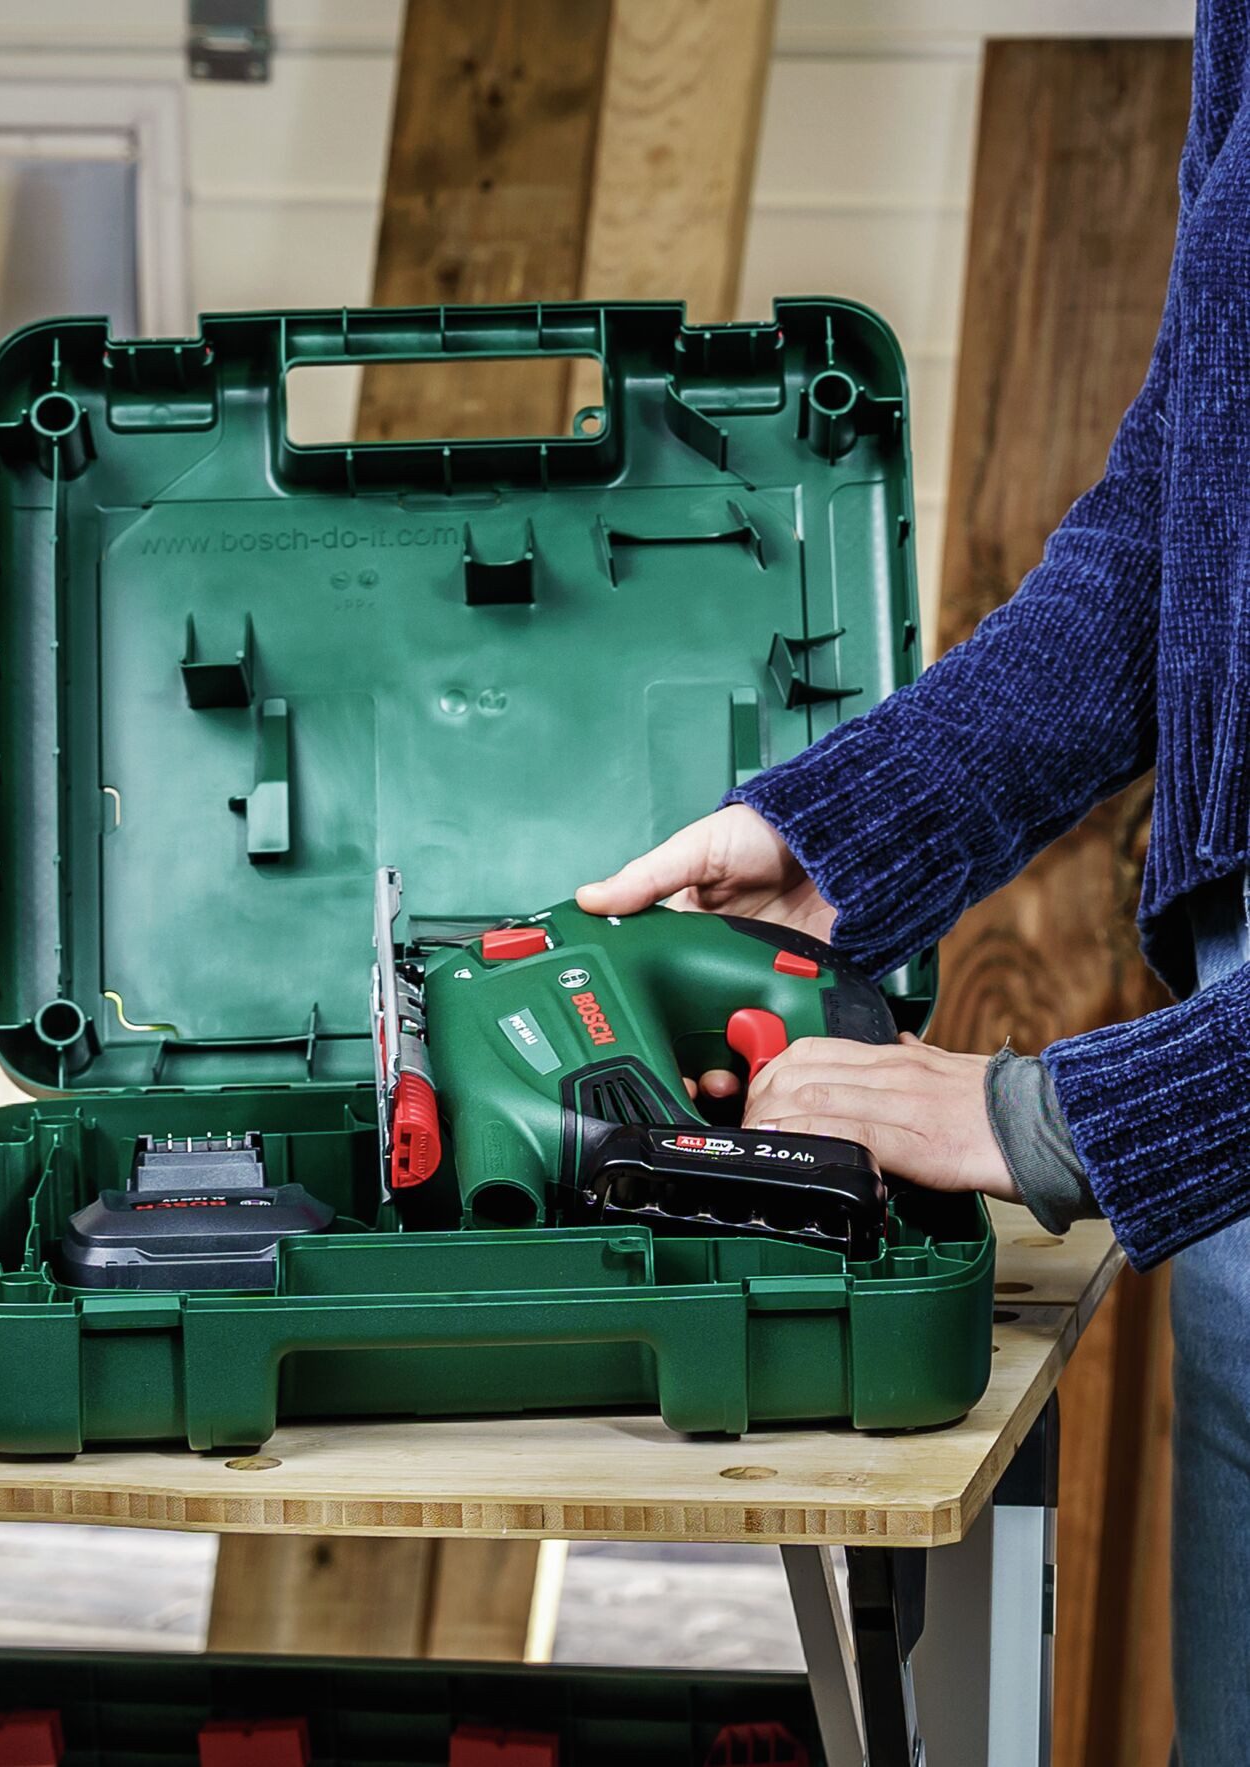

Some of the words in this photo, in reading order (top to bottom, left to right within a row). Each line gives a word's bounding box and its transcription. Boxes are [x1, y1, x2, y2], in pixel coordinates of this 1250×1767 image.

[141, 526, 460, 555] www.bosch-do-it.com
[571, 991, 616, 1045] BOSCH
[680, 1137, 704, 1147] ALL
[753, 1144, 790, 1160] 2.0
[791, 1151, 815, 1163] Ah
